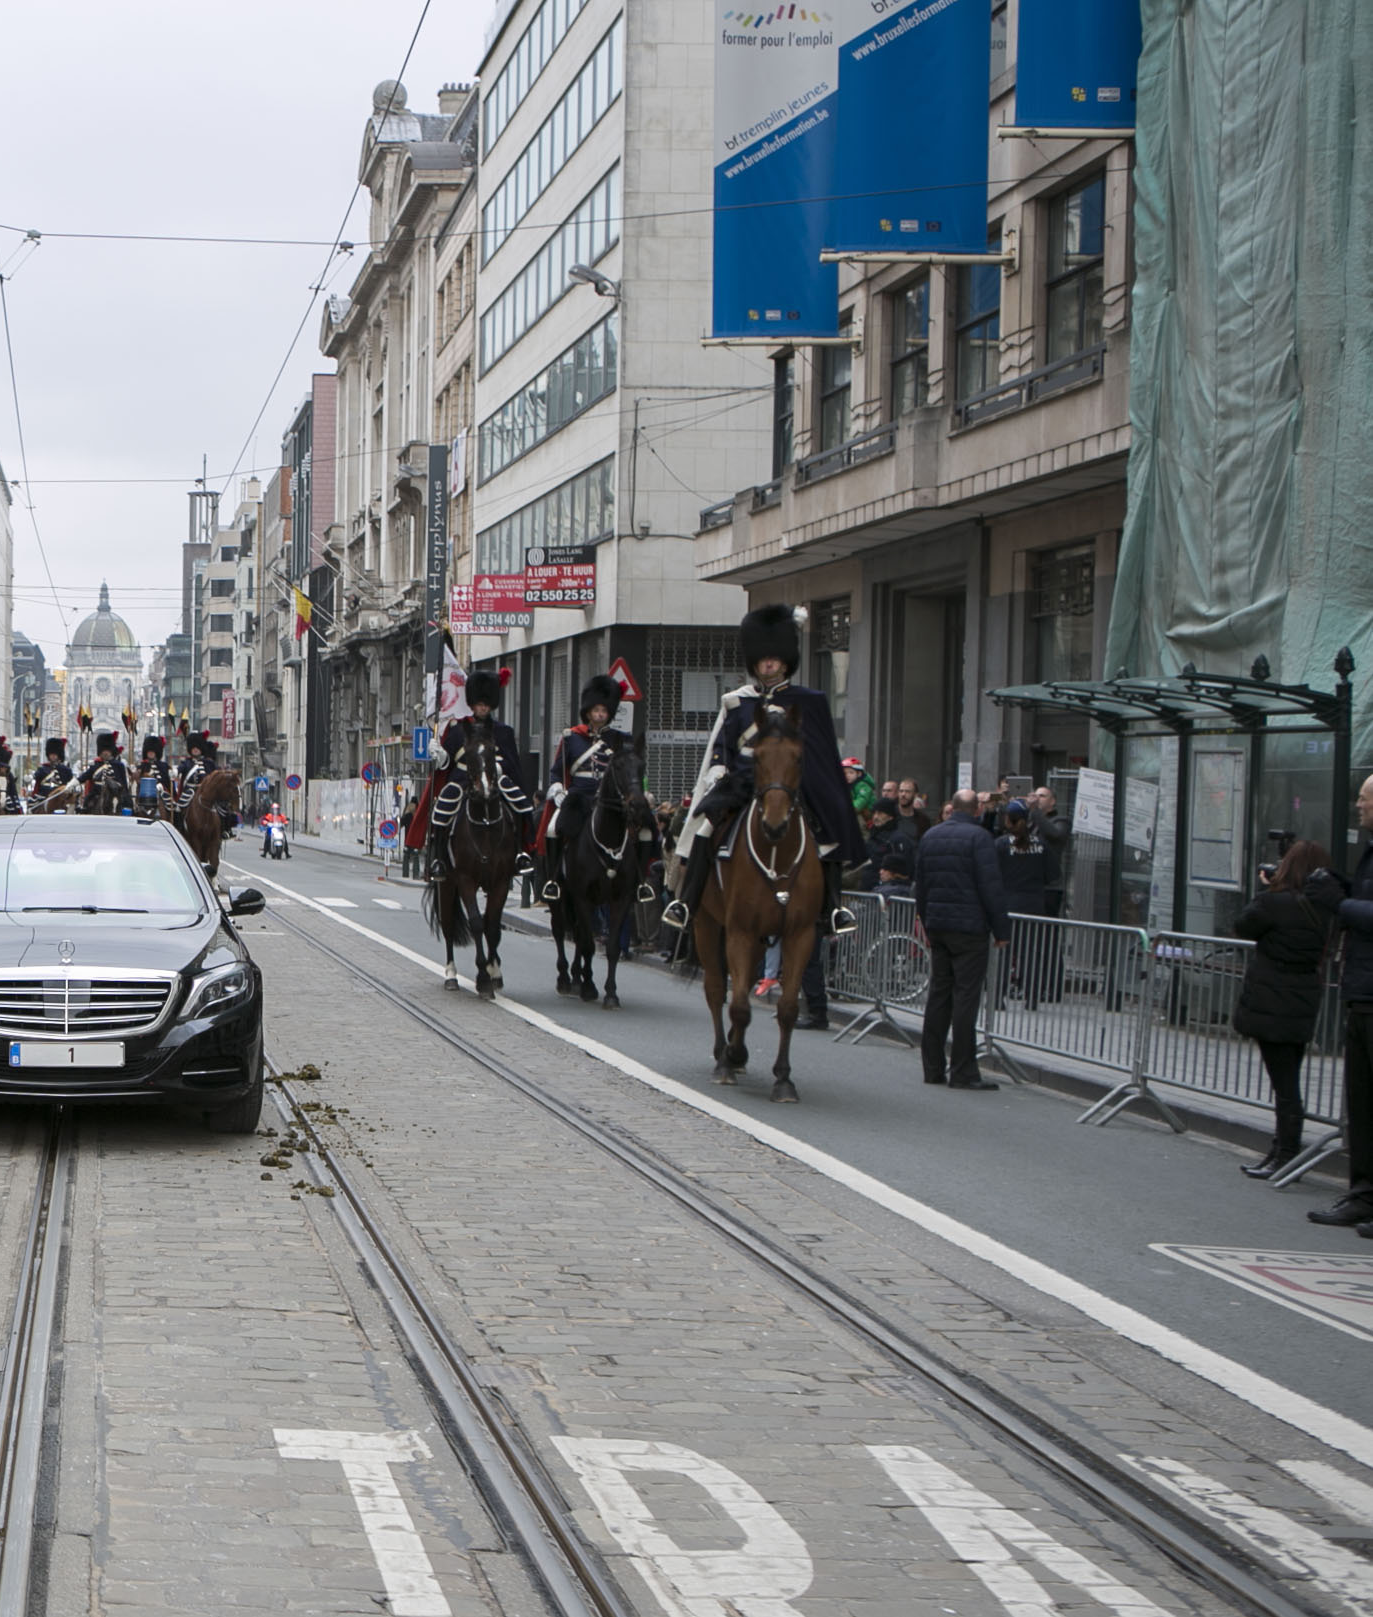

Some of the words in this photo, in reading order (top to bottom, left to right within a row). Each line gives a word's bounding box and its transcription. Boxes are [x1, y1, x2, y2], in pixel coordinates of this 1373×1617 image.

[722, 29, 757, 46] former
[761, 36, 784, 50] pour
[789, 30, 833, 49] l'emploi
[724, 107, 787, 150] bf.tremplin
[787, 81, 829, 115] jeunes
[724, 108, 830, 178] www.bruxellesformation.be
[429, 480, 444, 590] Hopplynus
[527, 567, 533, 577] A
[534, 567, 558, 577] LOUER
[563, 566, 572, 576] TE
[573, 565, 594, 576] HUUR
[526, 590, 540, 602] 02
[542, 590, 563, 601] 550
[564, 589, 579, 601] 25
[580, 588, 595, 600] 25
[454, 602, 467, 611] TO
[428, 597, 441, 637] Van
[476, 614, 486, 625] 02
[488, 614, 502, 625] 514
[505, 614, 515, 625] 40
[518, 614, 530, 625] 00
[453, 624, 464, 633] 02
[68, 1047, 75, 1063] 1
